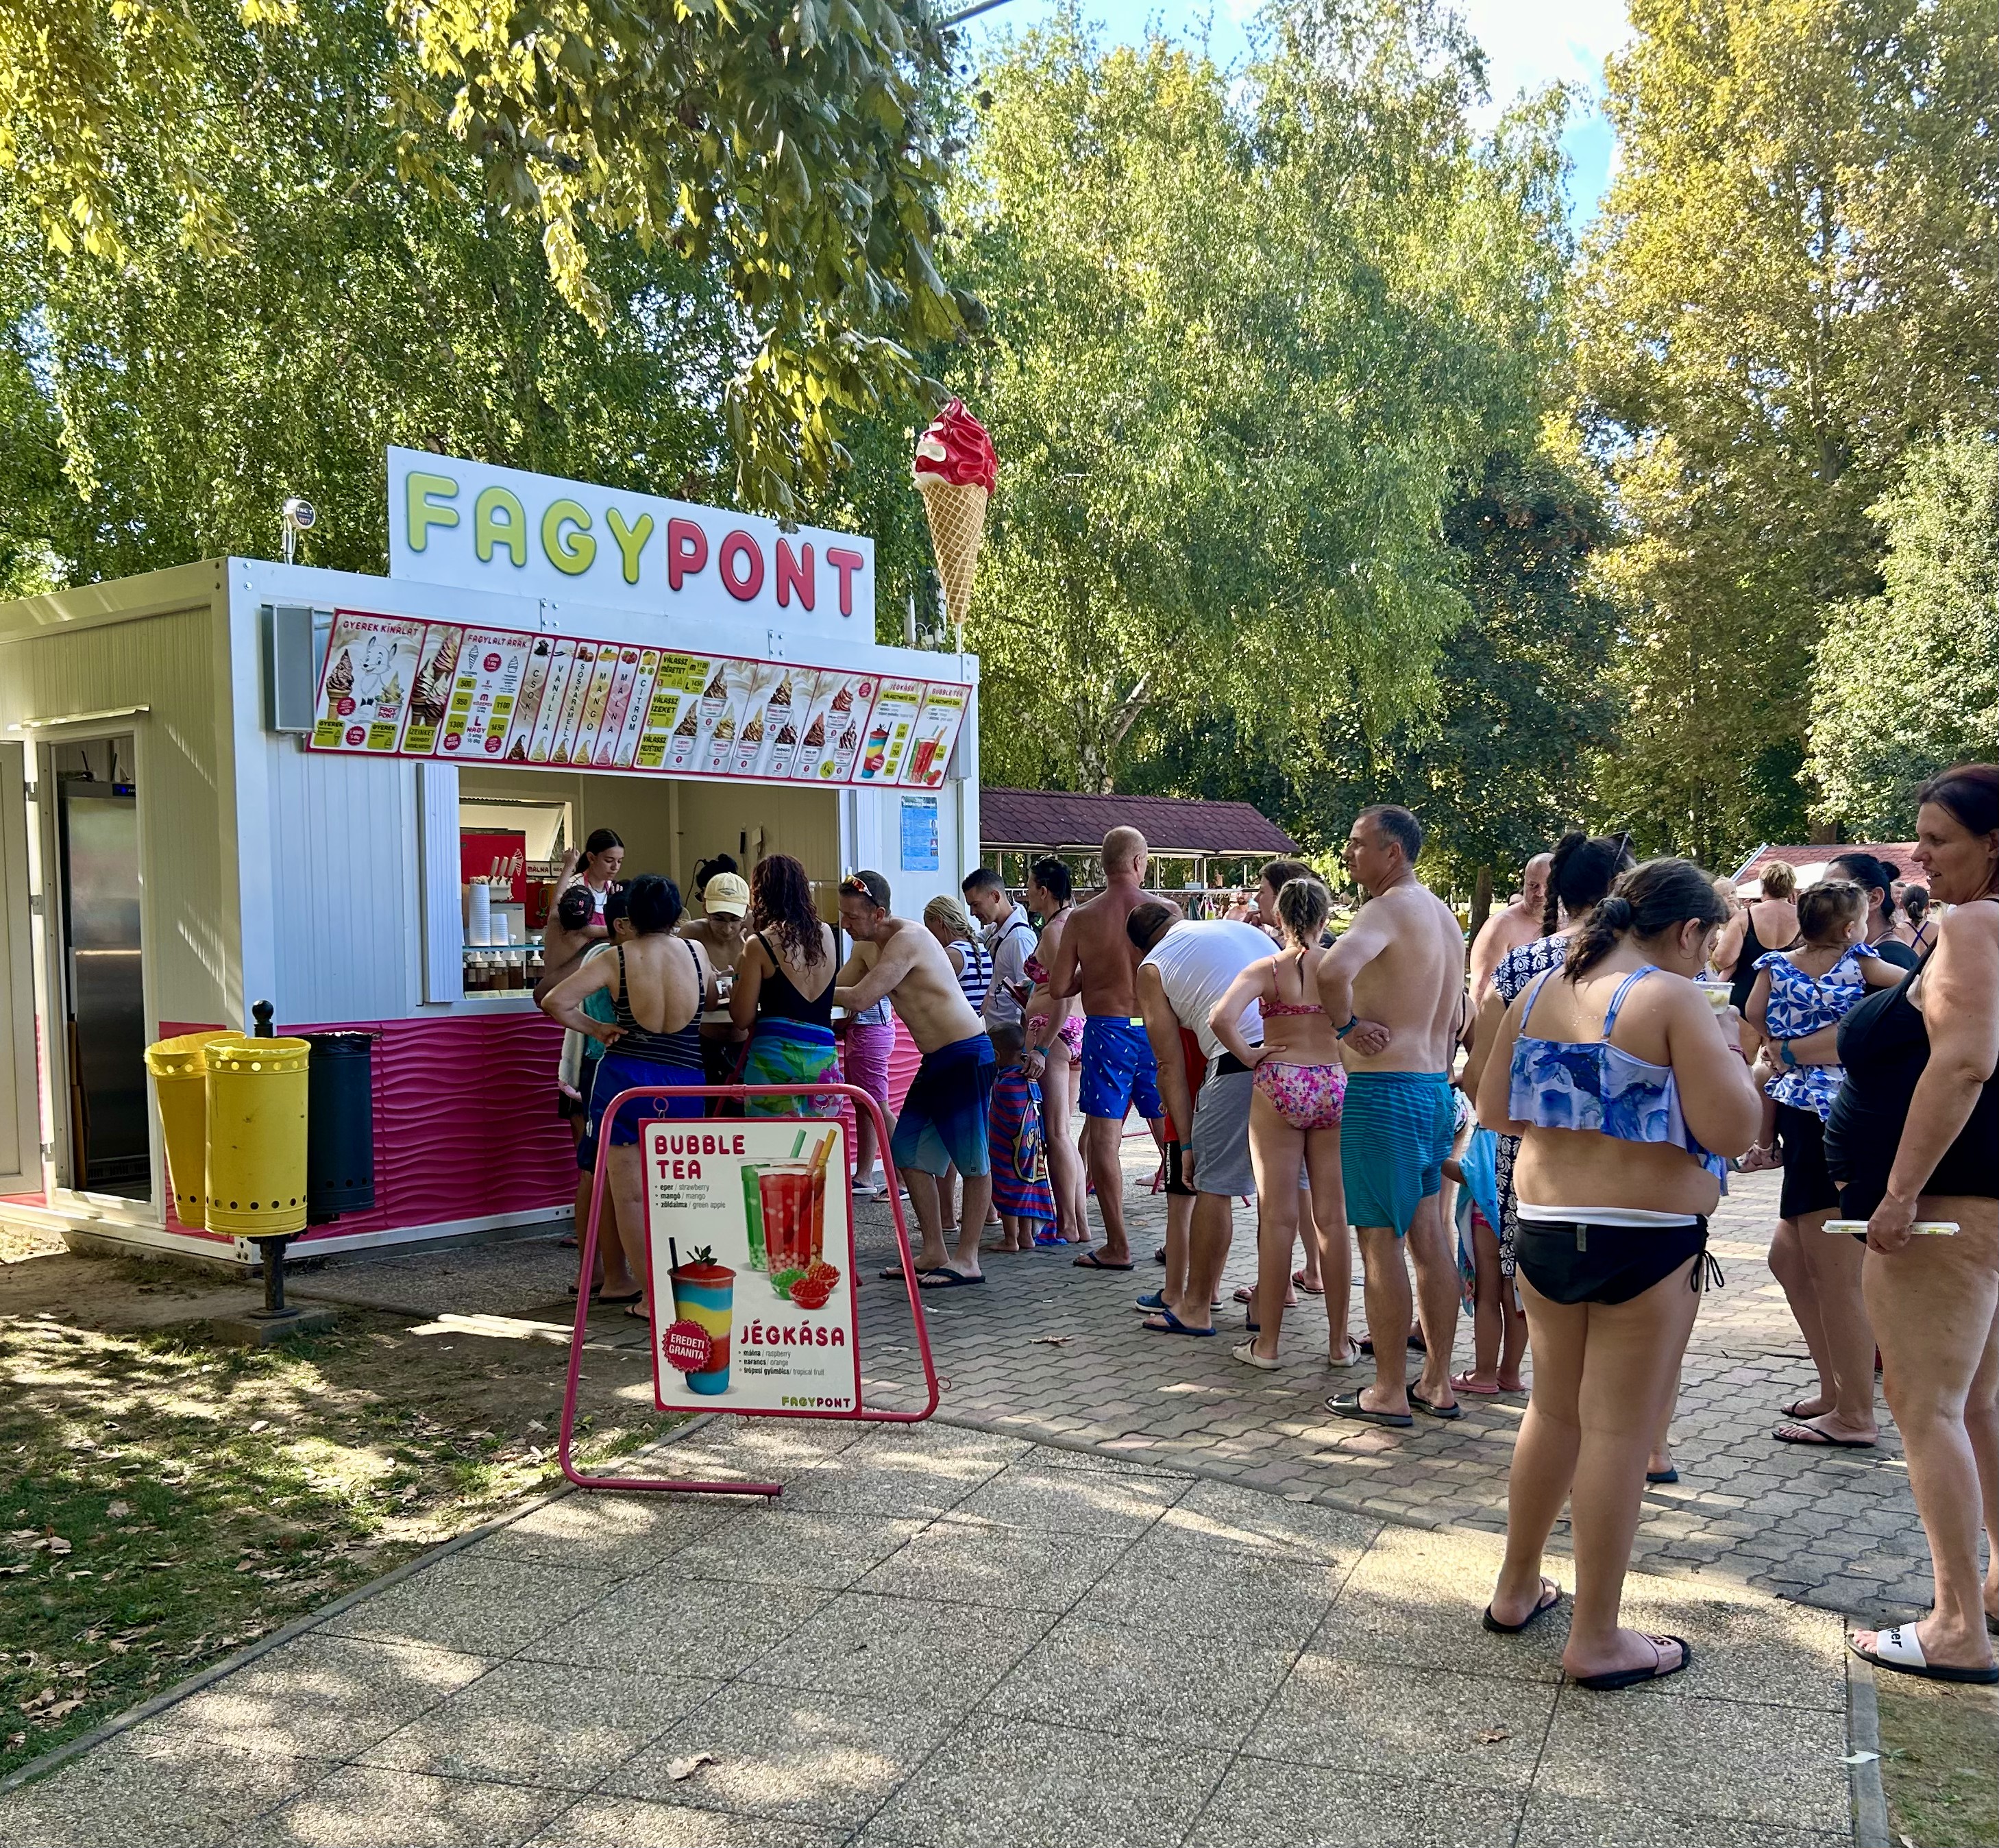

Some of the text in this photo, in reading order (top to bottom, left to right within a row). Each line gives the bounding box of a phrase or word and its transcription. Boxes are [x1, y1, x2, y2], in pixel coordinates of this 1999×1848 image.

[404, 471, 863, 617] FAGYPONT
[343, 621, 379, 632] GYEREK
[467, 635, 528, 648] FAGYLALT ÁRAK
[663, 655, 689, 665] VÁLASSZ
[524, 669, 540, 720] CSOKI
[543, 665, 564, 731] VANÍLIA
[932, 688, 953, 696] BUBBLE
[587, 672, 607, 730] MANGÓ
[629, 680, 647, 730] CITROM
[654, 1134, 746, 1155] BUBBLE
[656, 1159, 702, 1180] TEA
[678, 1183, 710, 1192] strawberry
[660, 1192, 680, 1200] mangó
[685, 1193, 706, 1201] mango
[740, 1318, 845, 1346] JÉGKÁSA
[670, 1333, 705, 1349] EREDETI
[669, 1344, 704, 1360] GRANITA
[765, 1350, 792, 1359] raspberry
[793, 1368, 812, 1377] tropical
[781, 1395, 851, 1408] FAGYPONT
